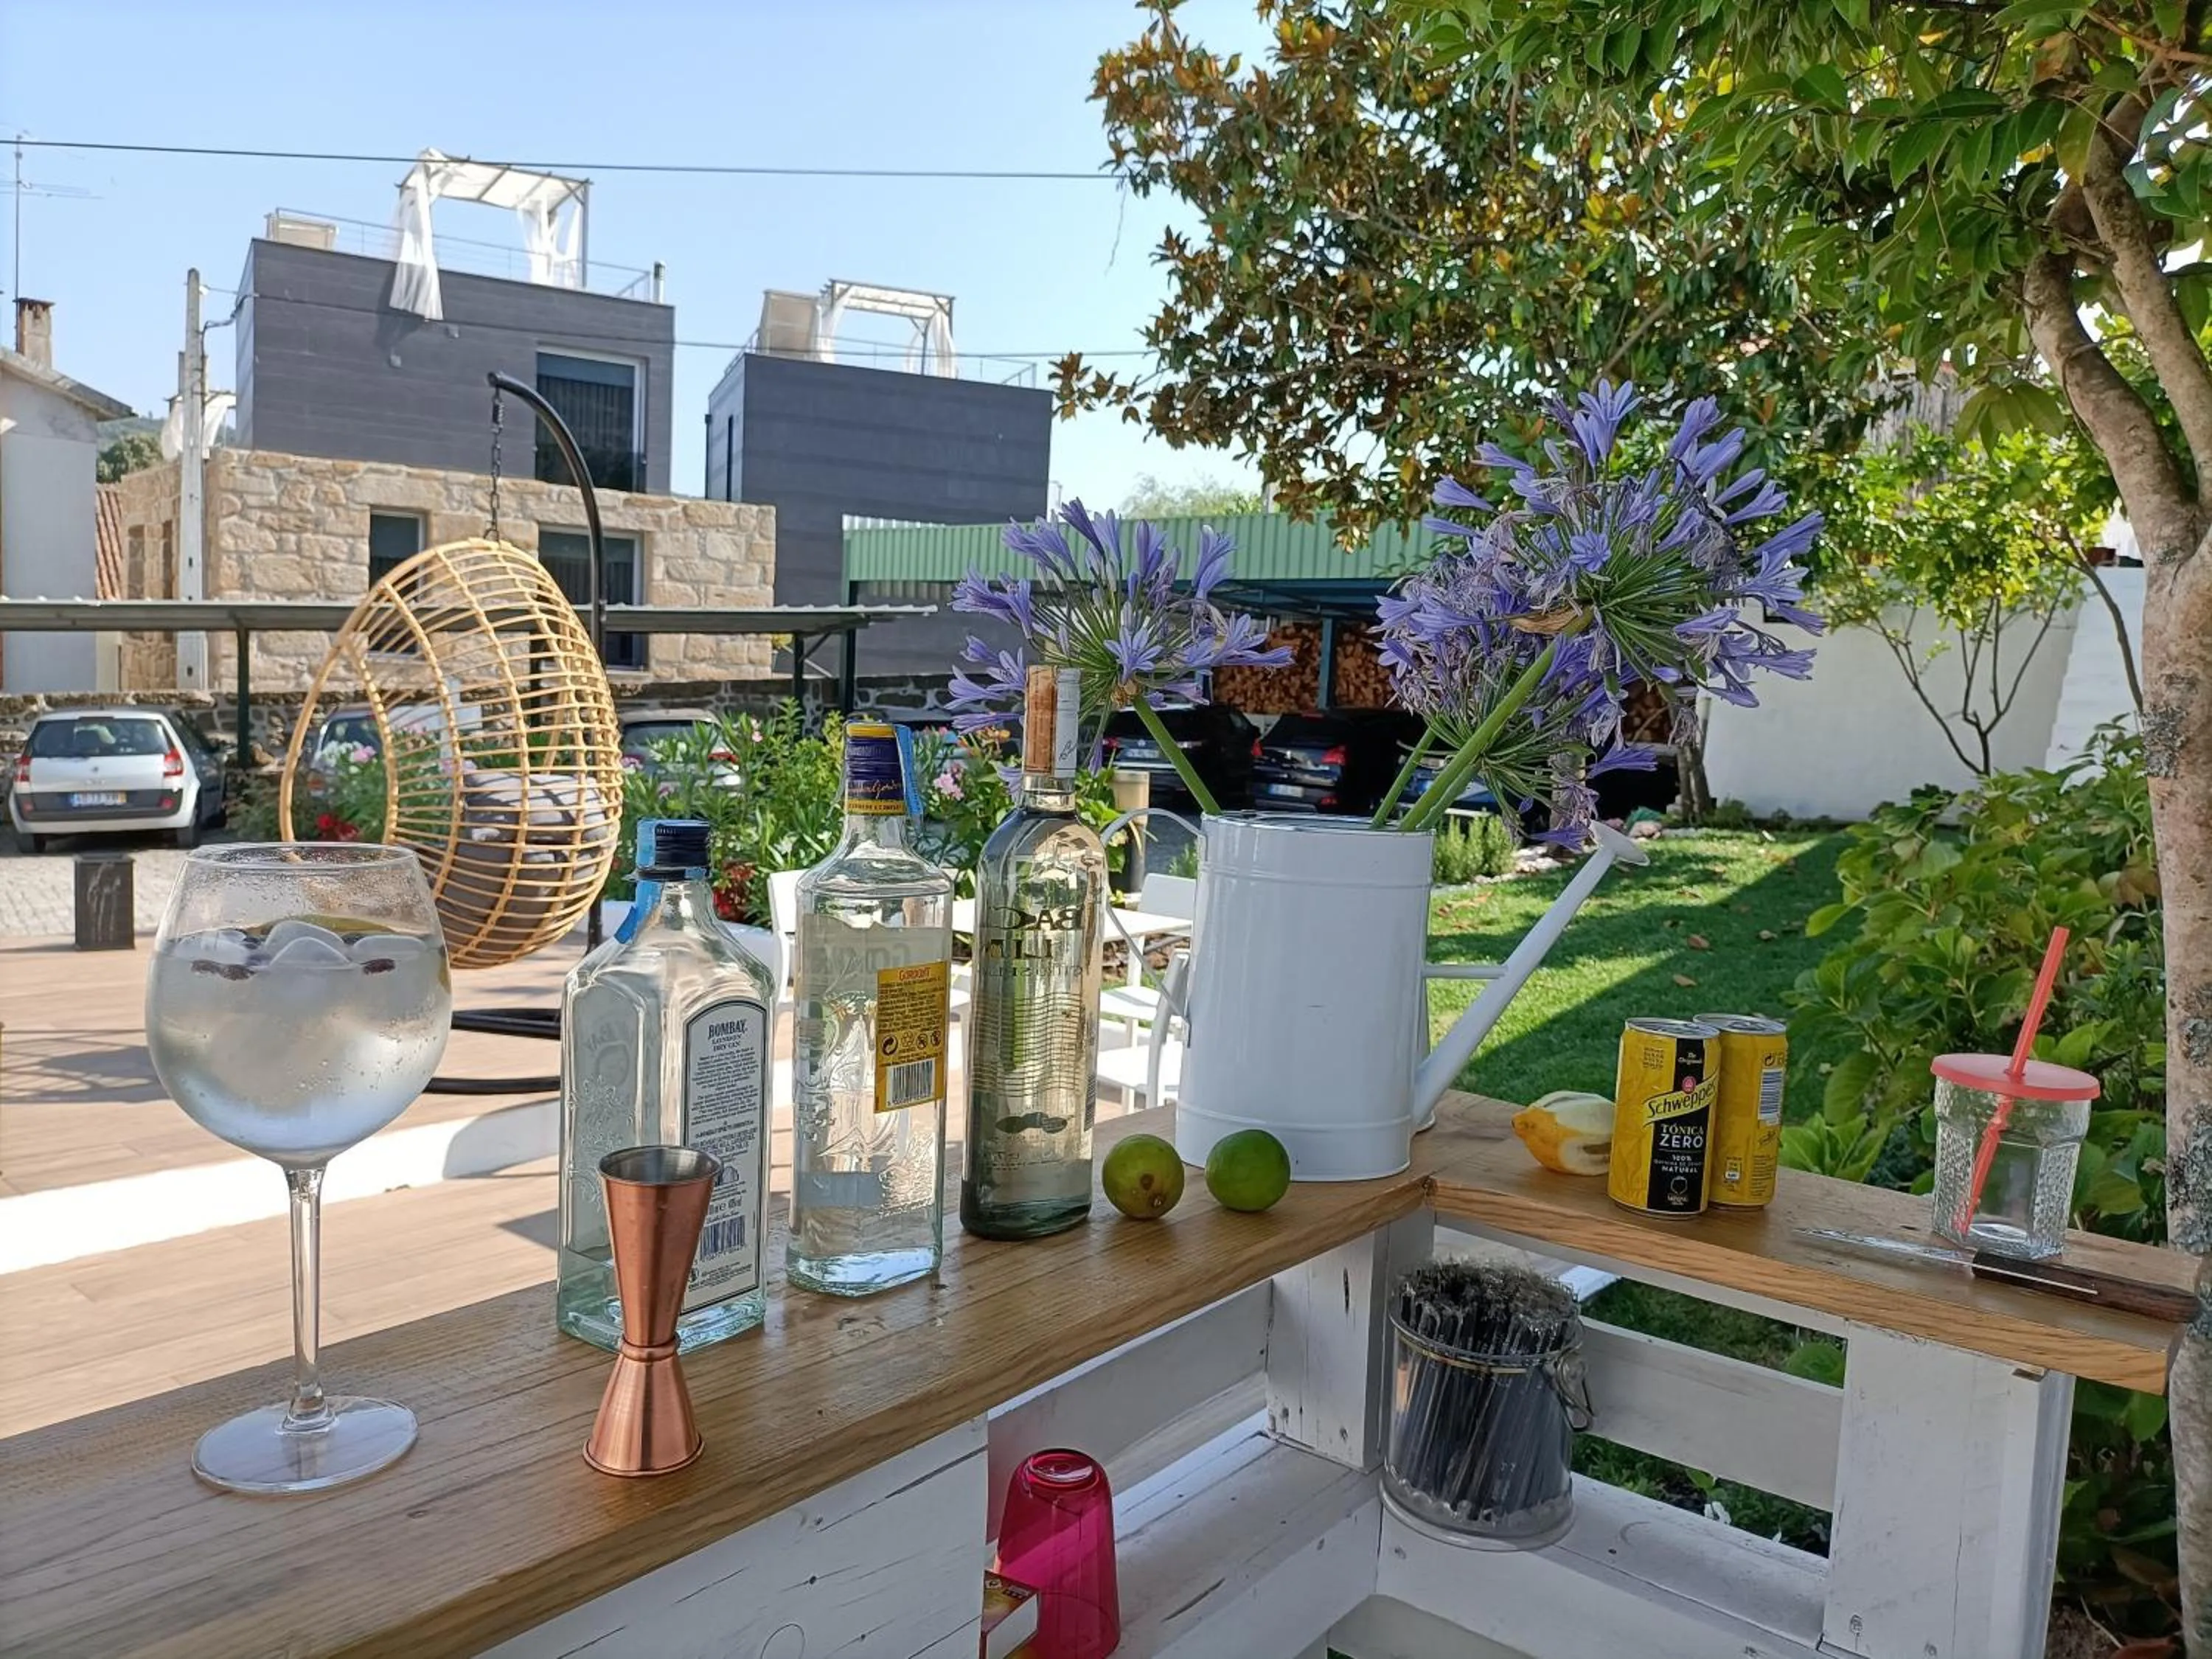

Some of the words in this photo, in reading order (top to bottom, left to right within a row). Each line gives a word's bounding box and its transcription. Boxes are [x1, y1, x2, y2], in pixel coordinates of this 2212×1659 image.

[708, 1018, 747, 1040] BOMBAY
[1660, 1121, 1704, 1136] TÓNICA
[1659, 1133, 1704, 1148] ZERO
[1661, 1165, 1698, 1173] NATURAL
